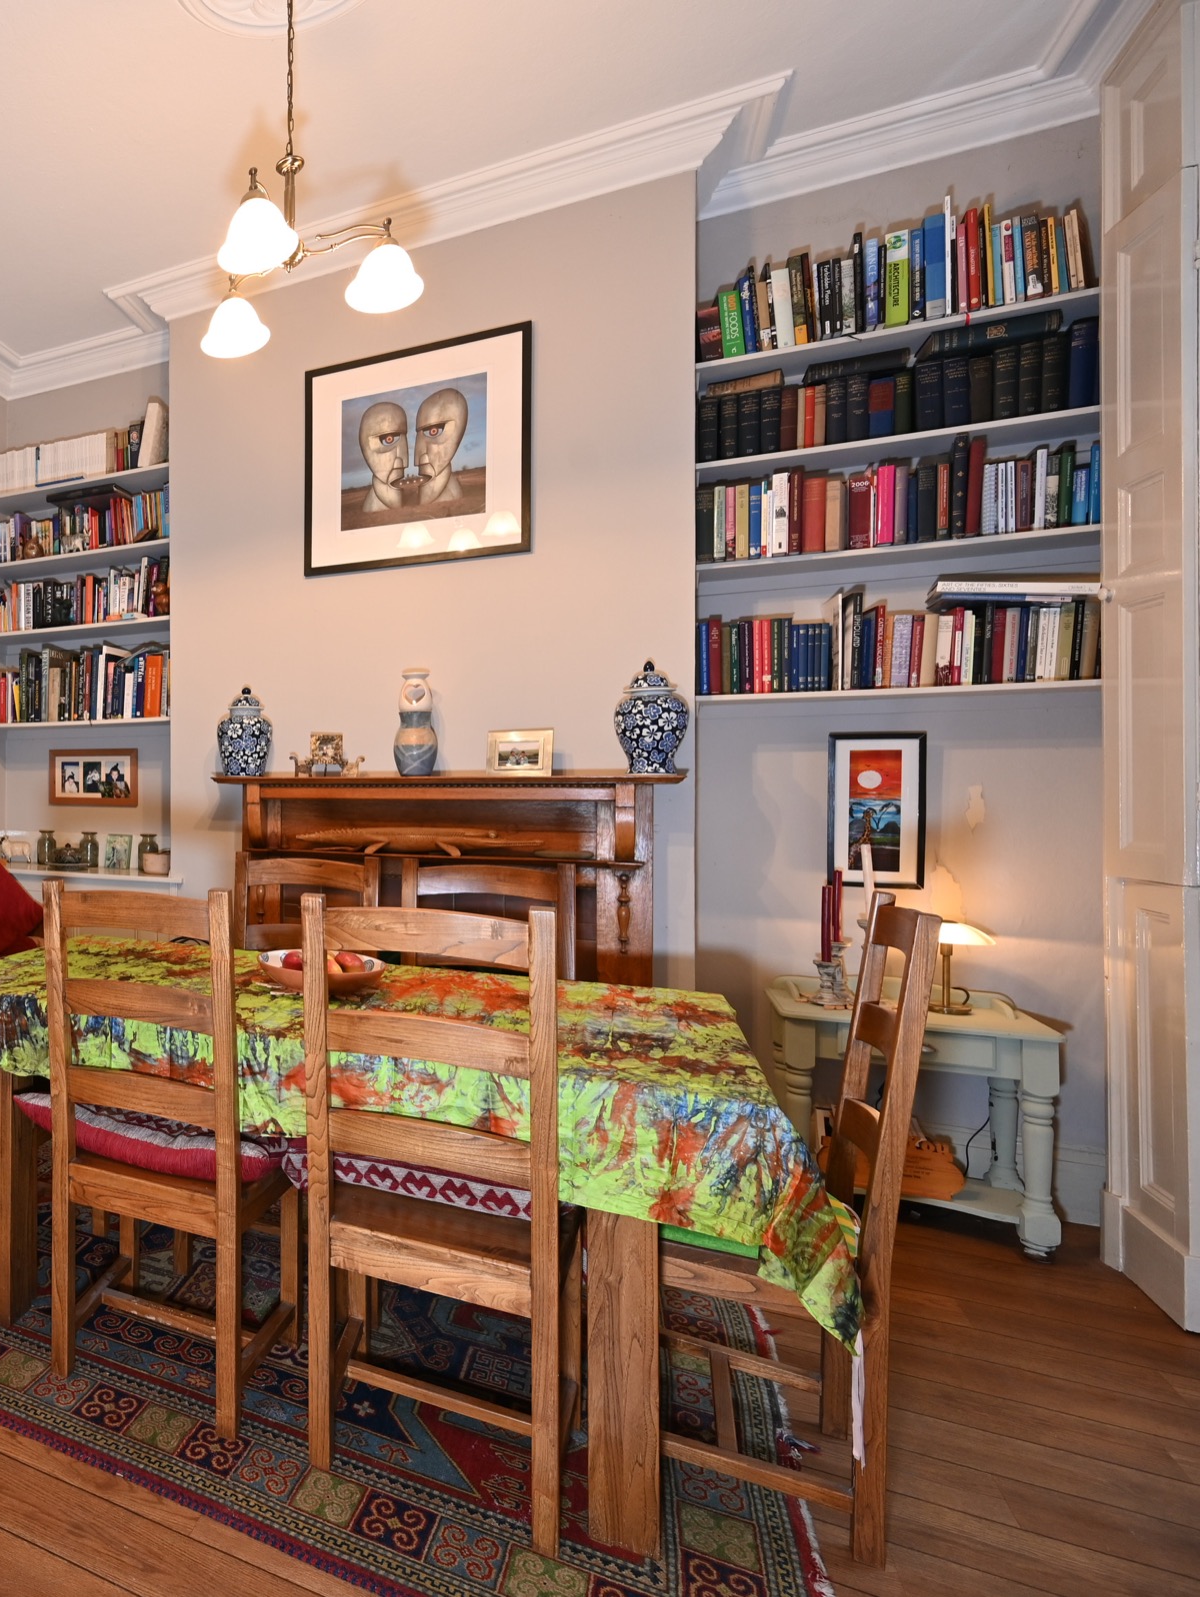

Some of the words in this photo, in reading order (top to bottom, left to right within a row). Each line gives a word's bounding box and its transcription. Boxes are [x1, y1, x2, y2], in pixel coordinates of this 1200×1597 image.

[868, 241, 877, 278] FRANCE
[892, 262, 900, 308] ARCHITECTURE
[728, 294, 737, 310] 1001
[729, 312, 740, 340] FOODS
[46, 604, 52, 614] AT
[853, 614, 861, 648] UPHOLLAND
